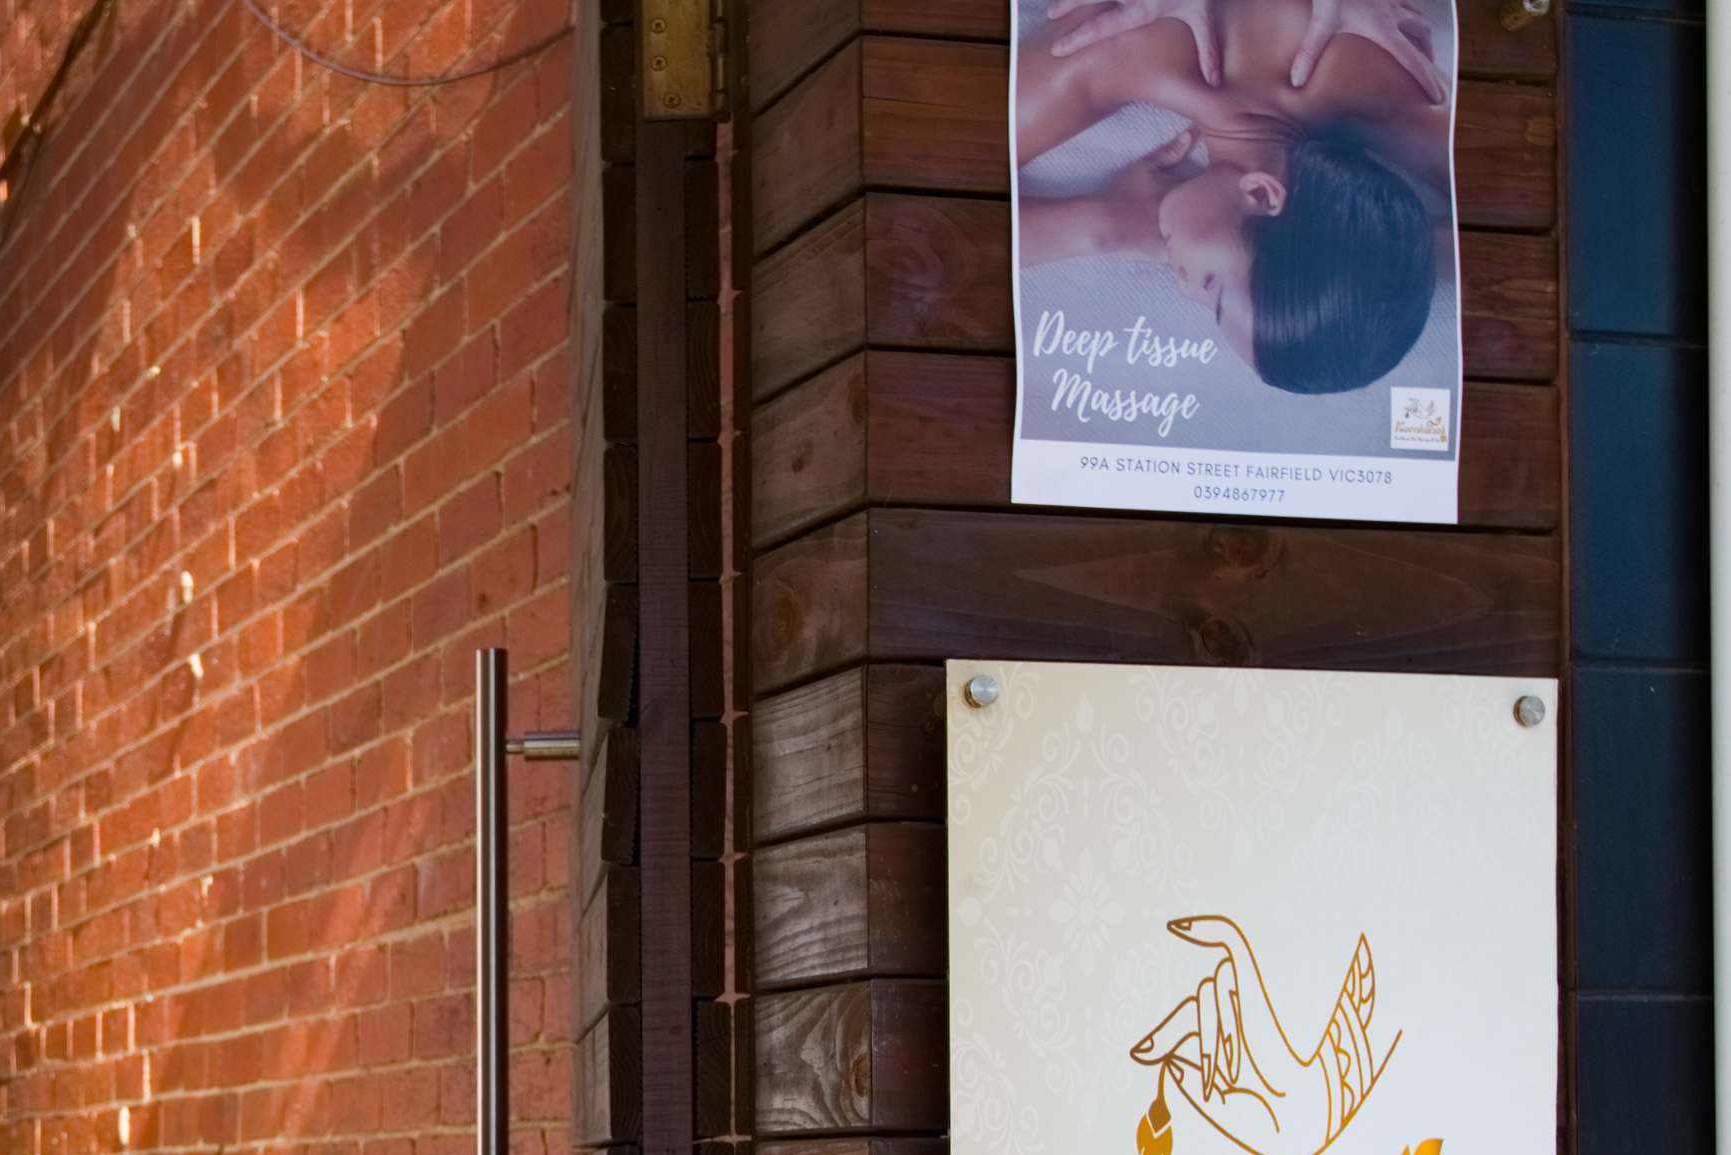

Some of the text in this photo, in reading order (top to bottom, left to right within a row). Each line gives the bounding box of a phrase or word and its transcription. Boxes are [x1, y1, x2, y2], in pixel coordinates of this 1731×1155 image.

[1033, 310, 1218, 373] Deep tissue
[1051, 368, 1200, 437] Massage
[1080, 456, 1392, 485] 99A STATION STREET FAIRFIELD VIC3078
[1194, 485, 1285, 502] 0394867977
